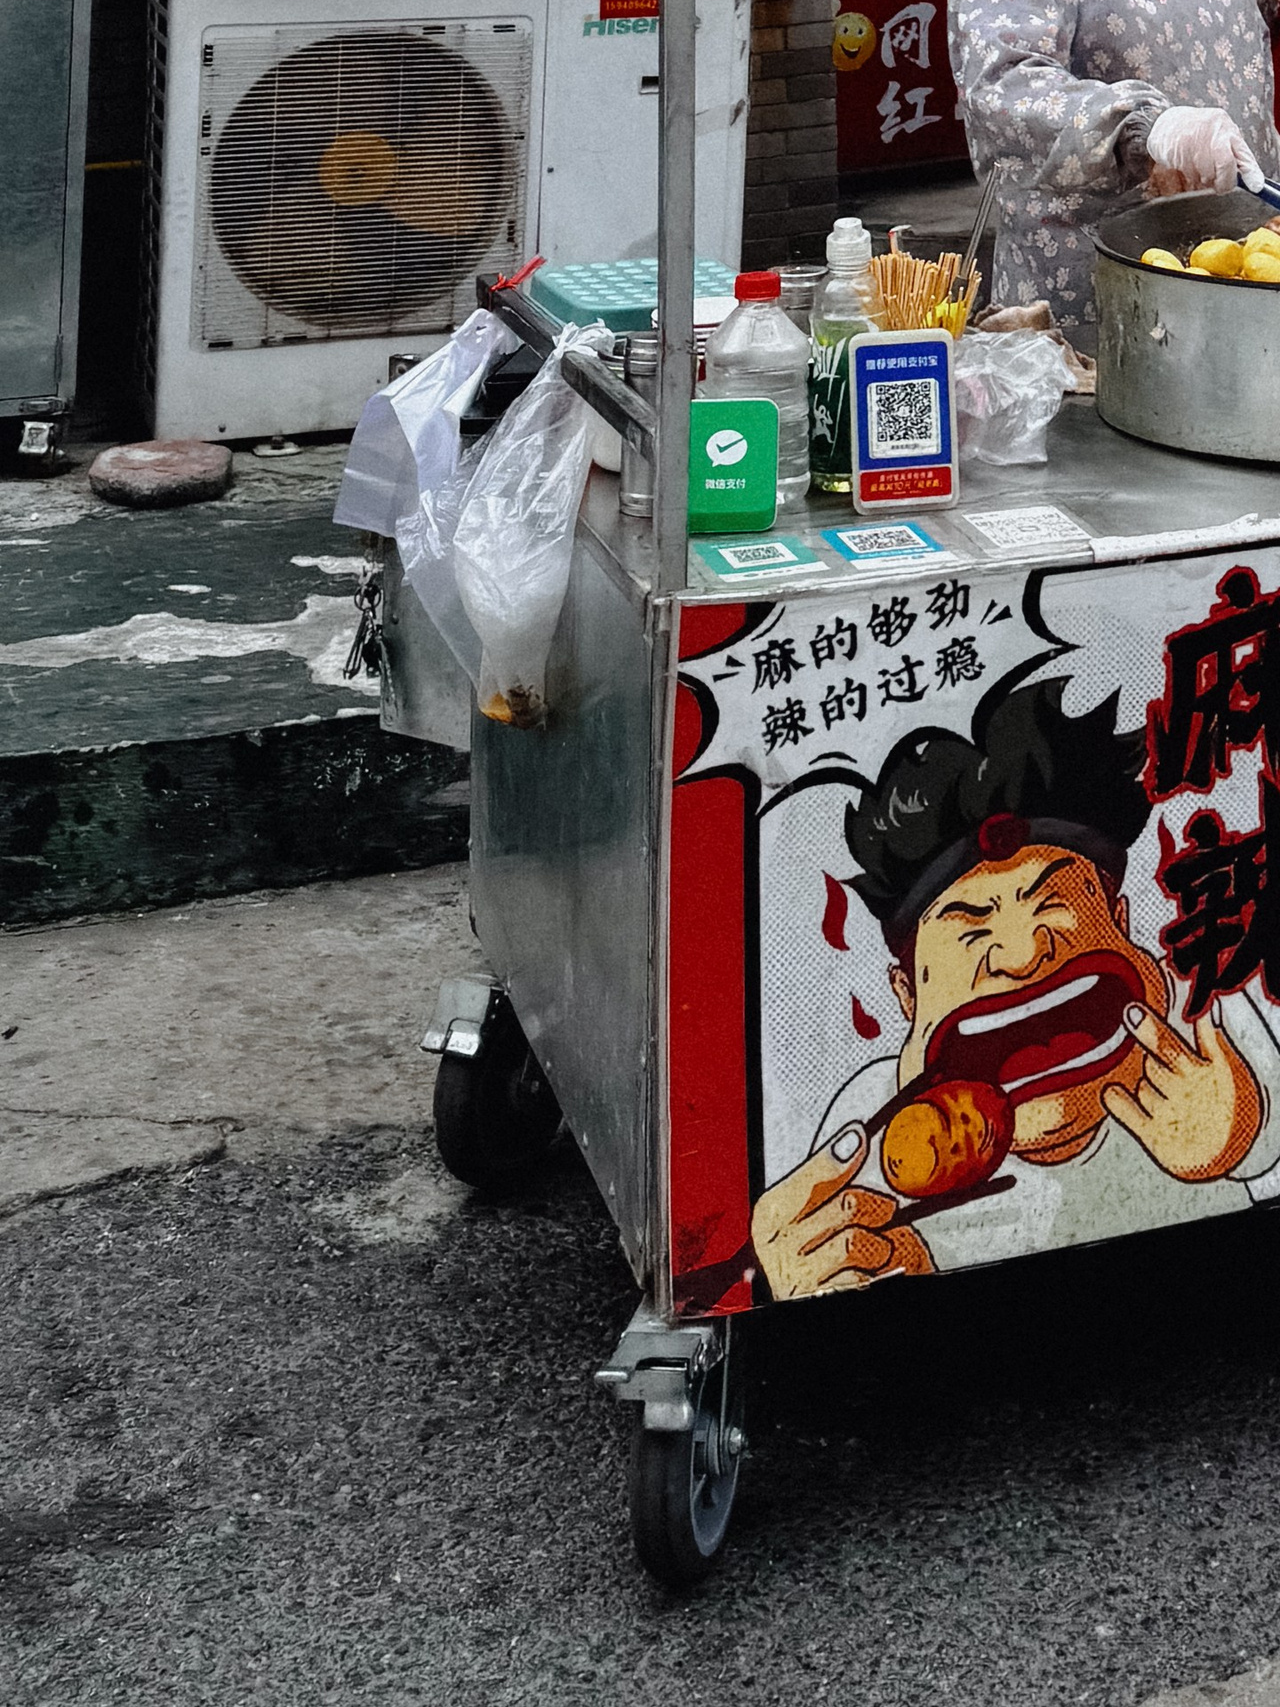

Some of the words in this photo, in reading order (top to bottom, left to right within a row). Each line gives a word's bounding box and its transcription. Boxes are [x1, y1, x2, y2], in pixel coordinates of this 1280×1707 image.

[877, 2, 942, 144] 网红
[705, 478, 746, 490] 微信支付
[752, 578, 971, 695] 麻的够劲
[761, 635, 987, 757] 辣的过瘾
